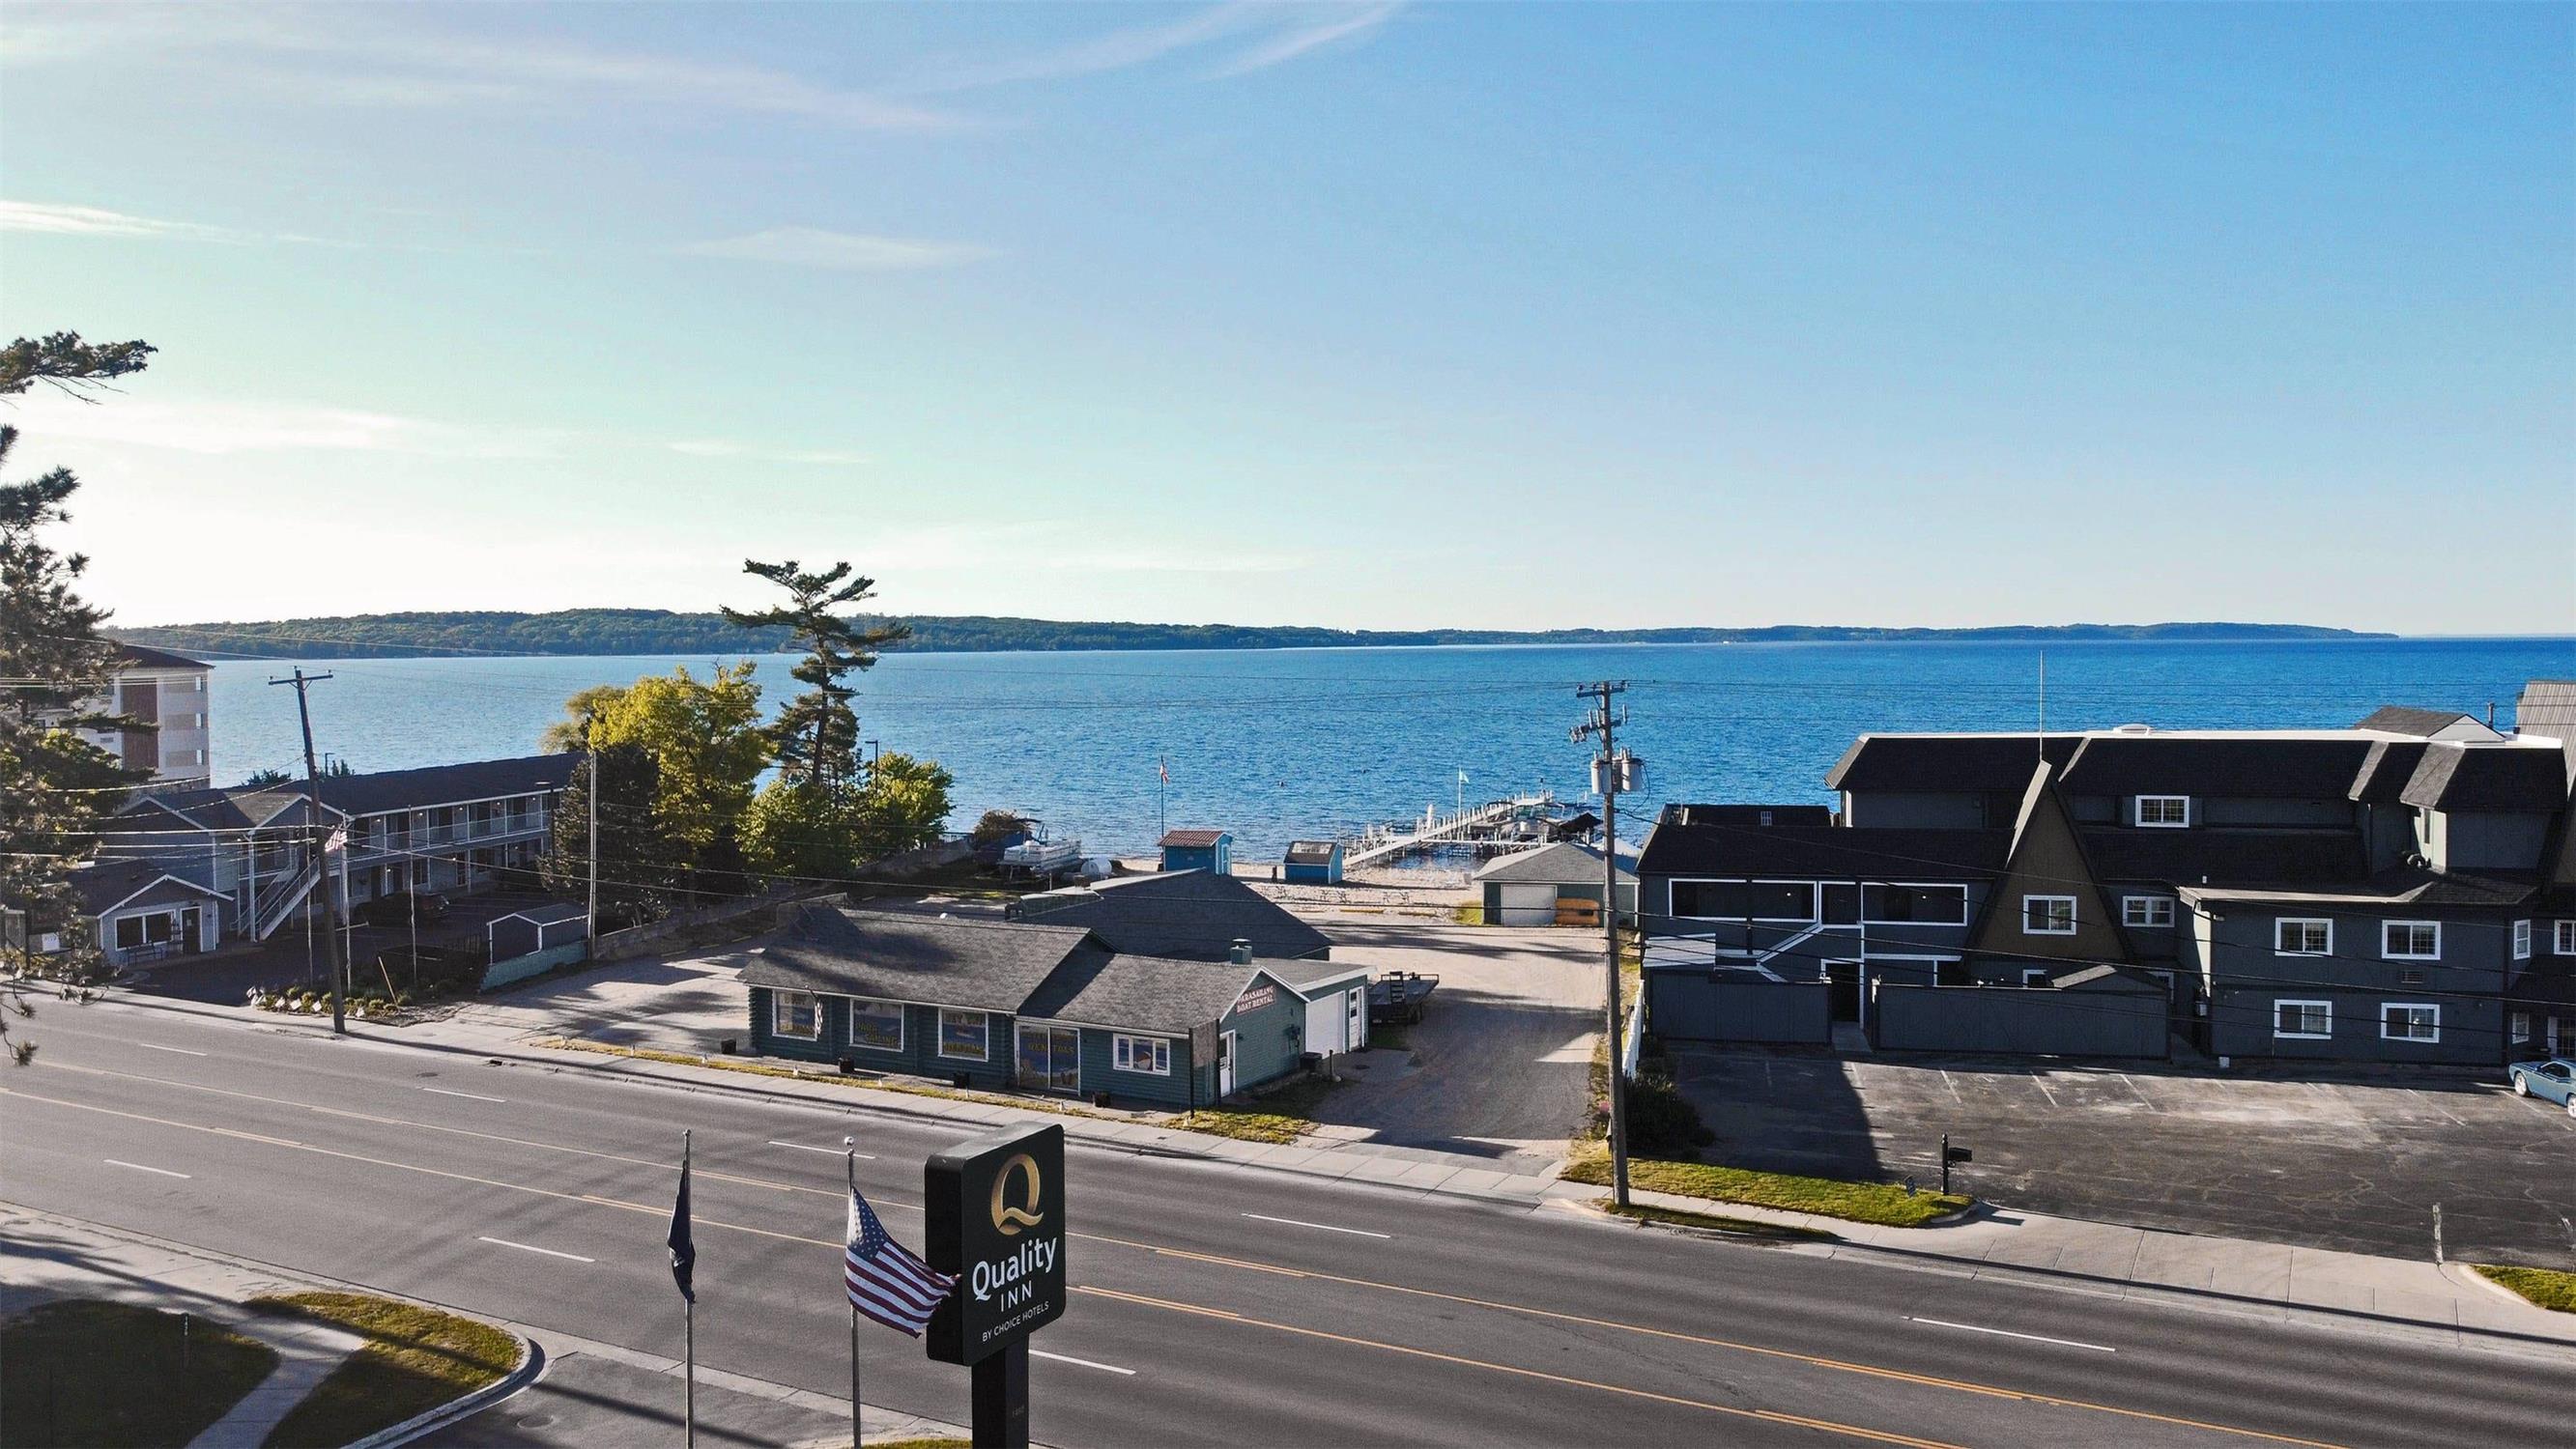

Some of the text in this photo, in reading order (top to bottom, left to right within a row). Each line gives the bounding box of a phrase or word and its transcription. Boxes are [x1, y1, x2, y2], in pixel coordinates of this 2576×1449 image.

[991, 1153, 1044, 1236] Q
[972, 1237, 1057, 1301] Quality
[983, 1301, 1049, 1343] BY CHOICE HOTELS
[1001, 1280, 1032, 1312] INN
